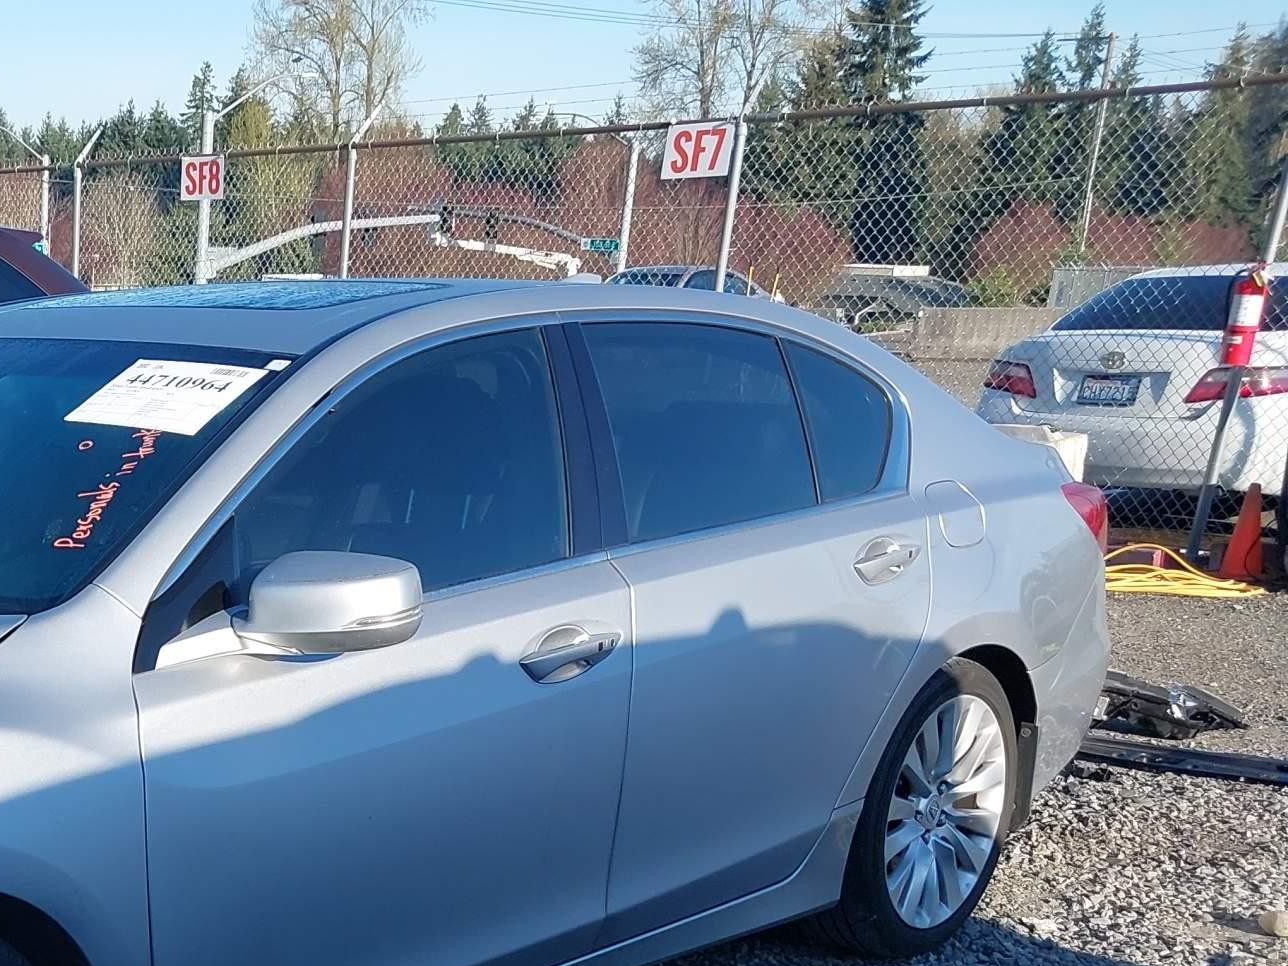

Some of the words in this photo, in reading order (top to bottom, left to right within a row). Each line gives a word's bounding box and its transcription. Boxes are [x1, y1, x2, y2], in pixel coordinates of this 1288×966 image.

[670, 128, 727, 174] SF7
[184, 160, 221, 196] SF8
[127, 373, 233, 393] 44710964
